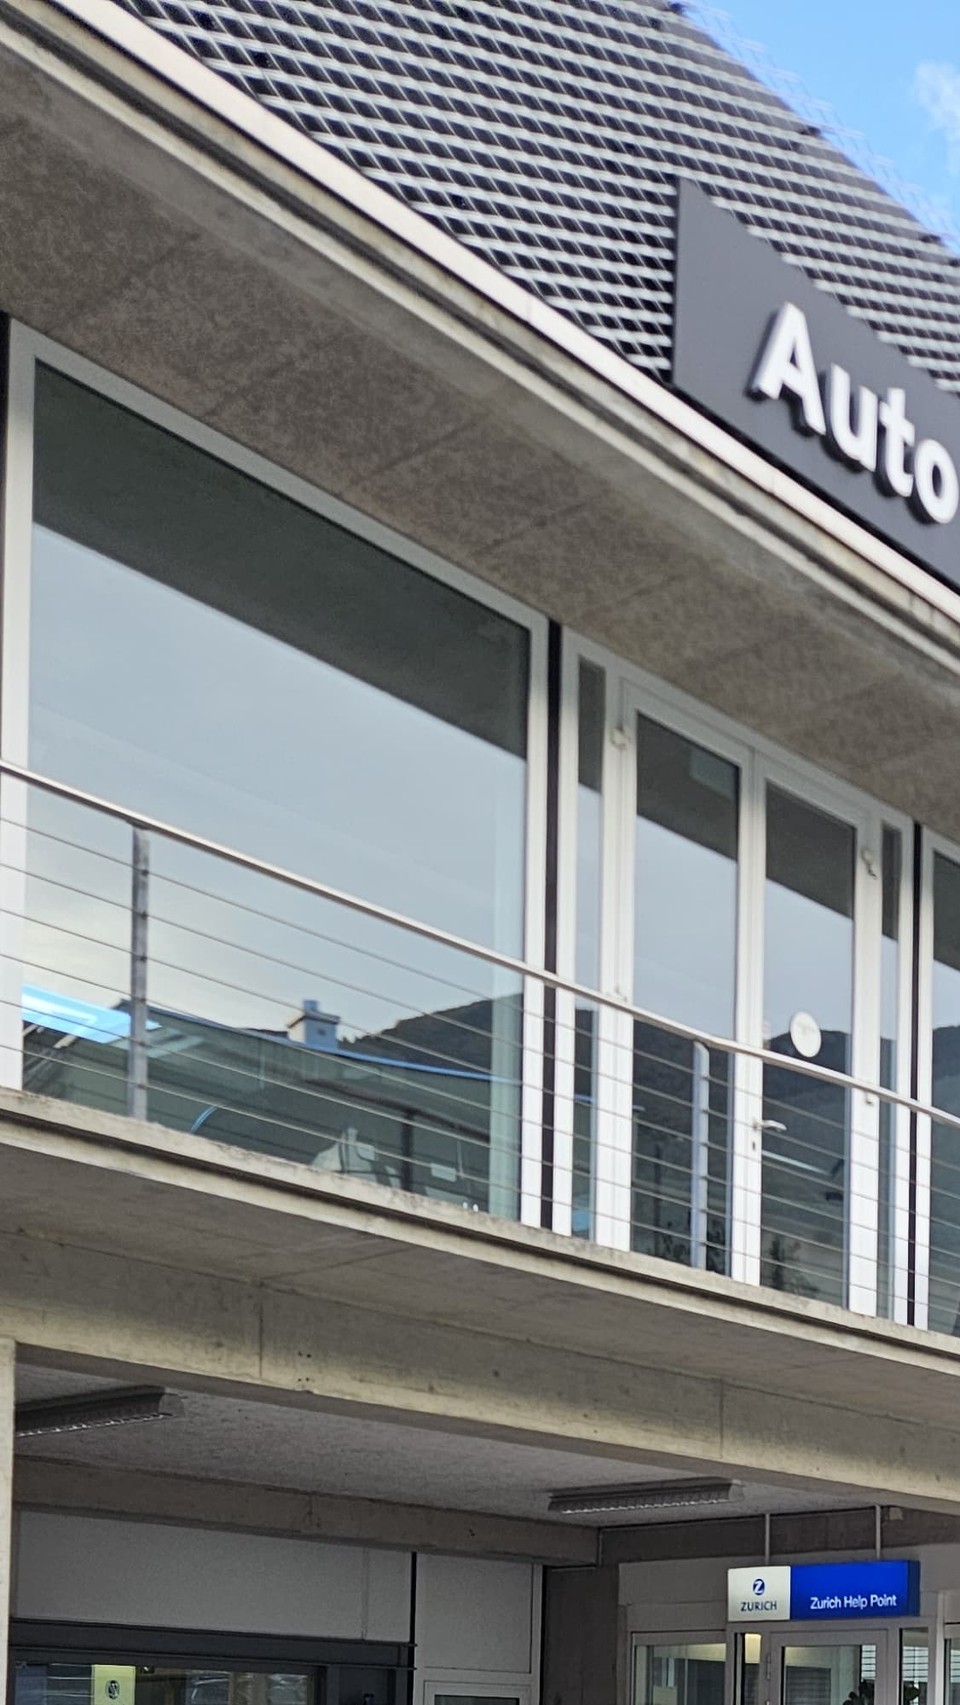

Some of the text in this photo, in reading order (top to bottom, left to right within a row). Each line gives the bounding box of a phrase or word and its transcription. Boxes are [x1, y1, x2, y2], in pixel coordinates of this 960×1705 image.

[752, 302, 960, 524] Auto
[740, 1601, 778, 1611] ZURICH
[810, 1594, 897, 1611] Zurich Help Point
